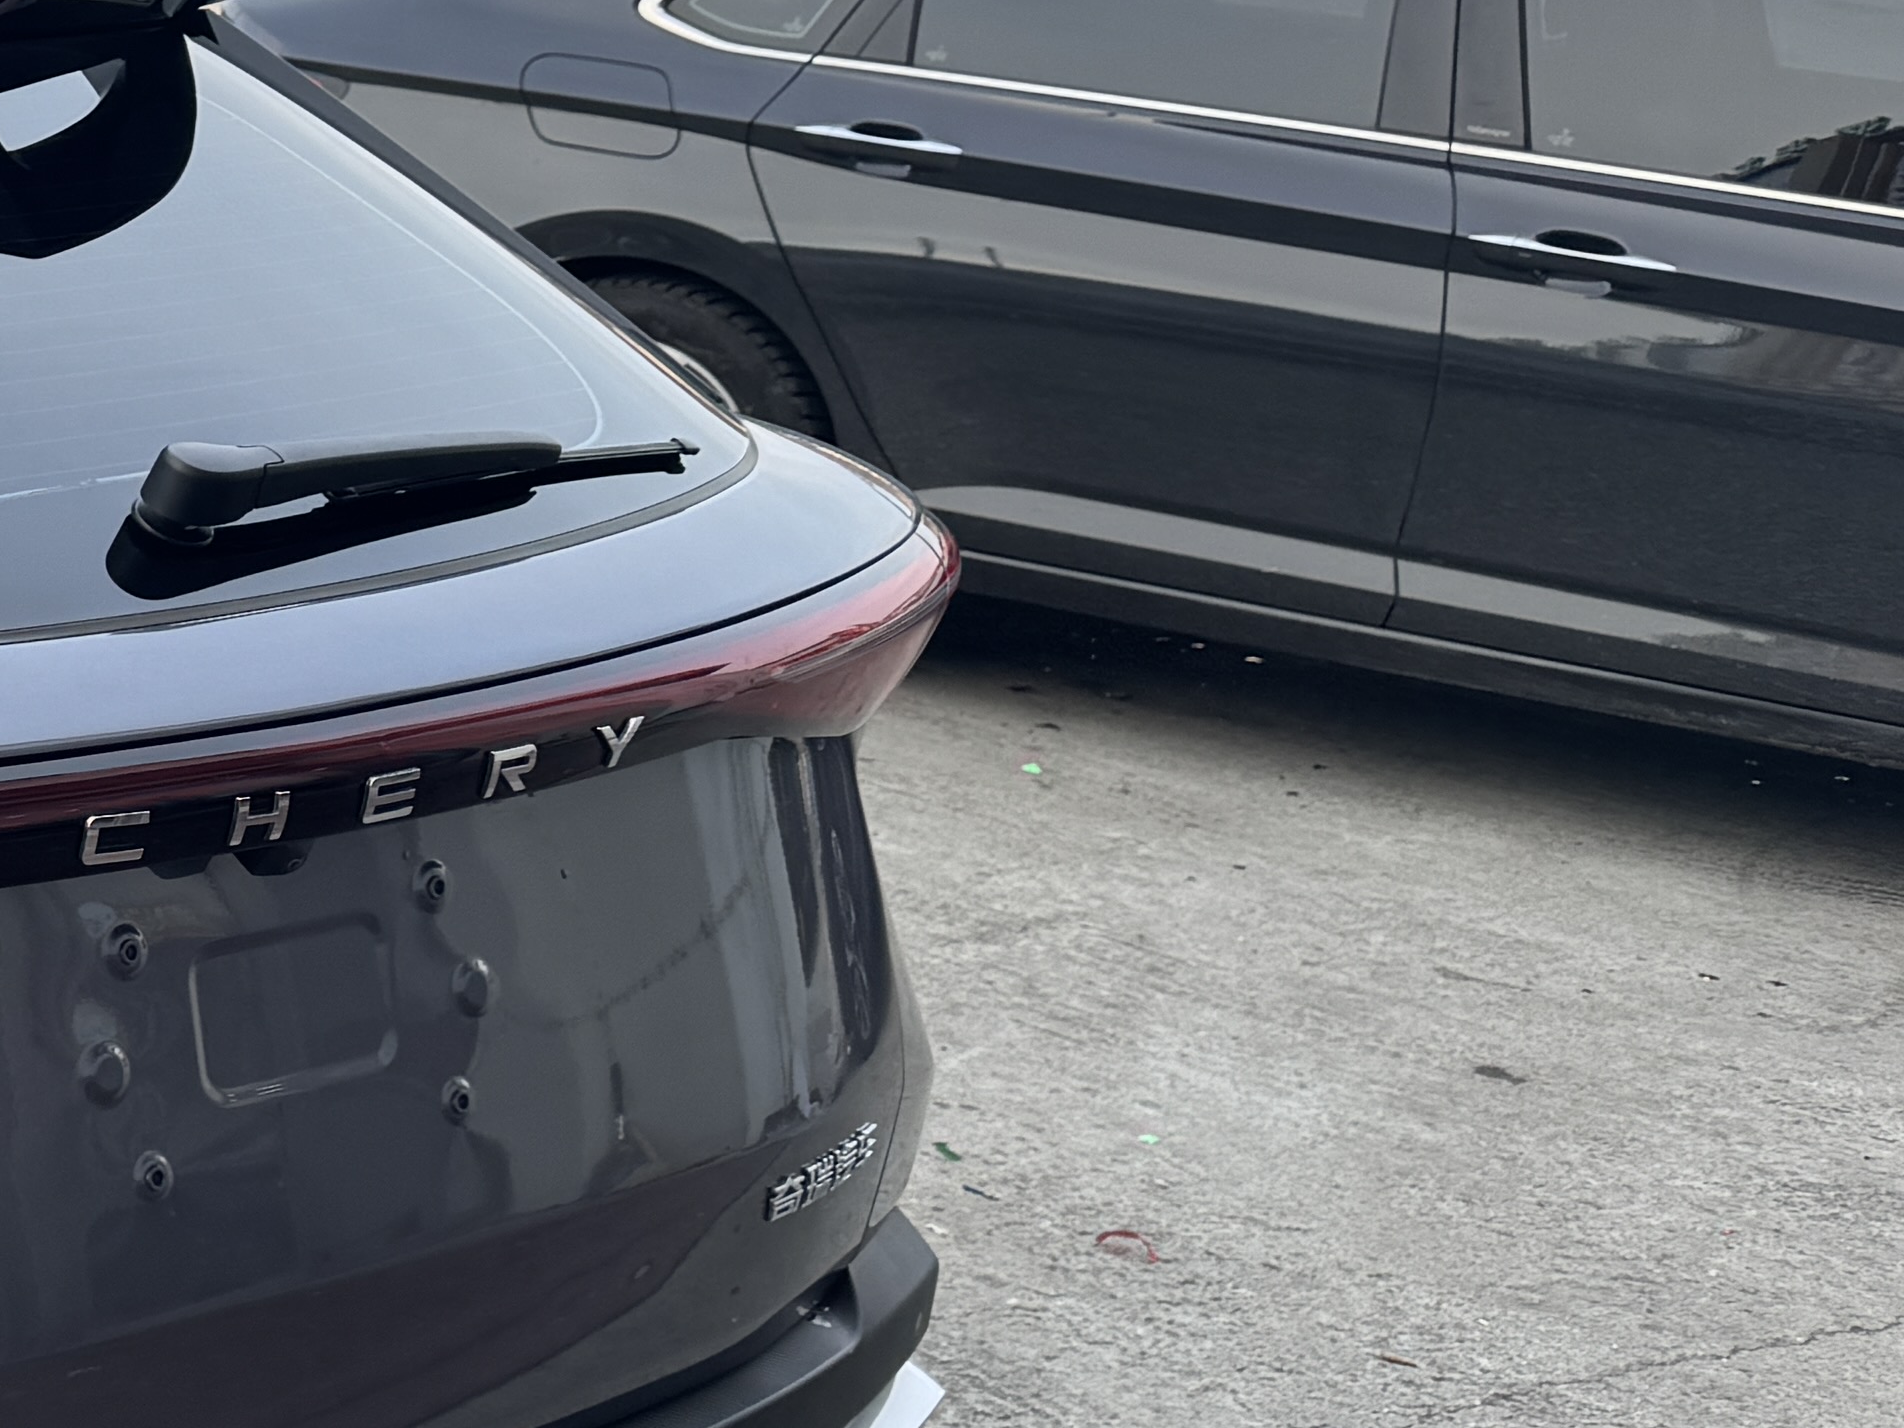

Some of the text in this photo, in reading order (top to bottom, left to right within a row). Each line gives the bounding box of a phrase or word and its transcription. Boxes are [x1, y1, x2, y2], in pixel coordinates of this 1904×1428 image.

[81, 715, 645, 866] CHERY
[768, 1122, 878, 1222] 奇瑞汽车
